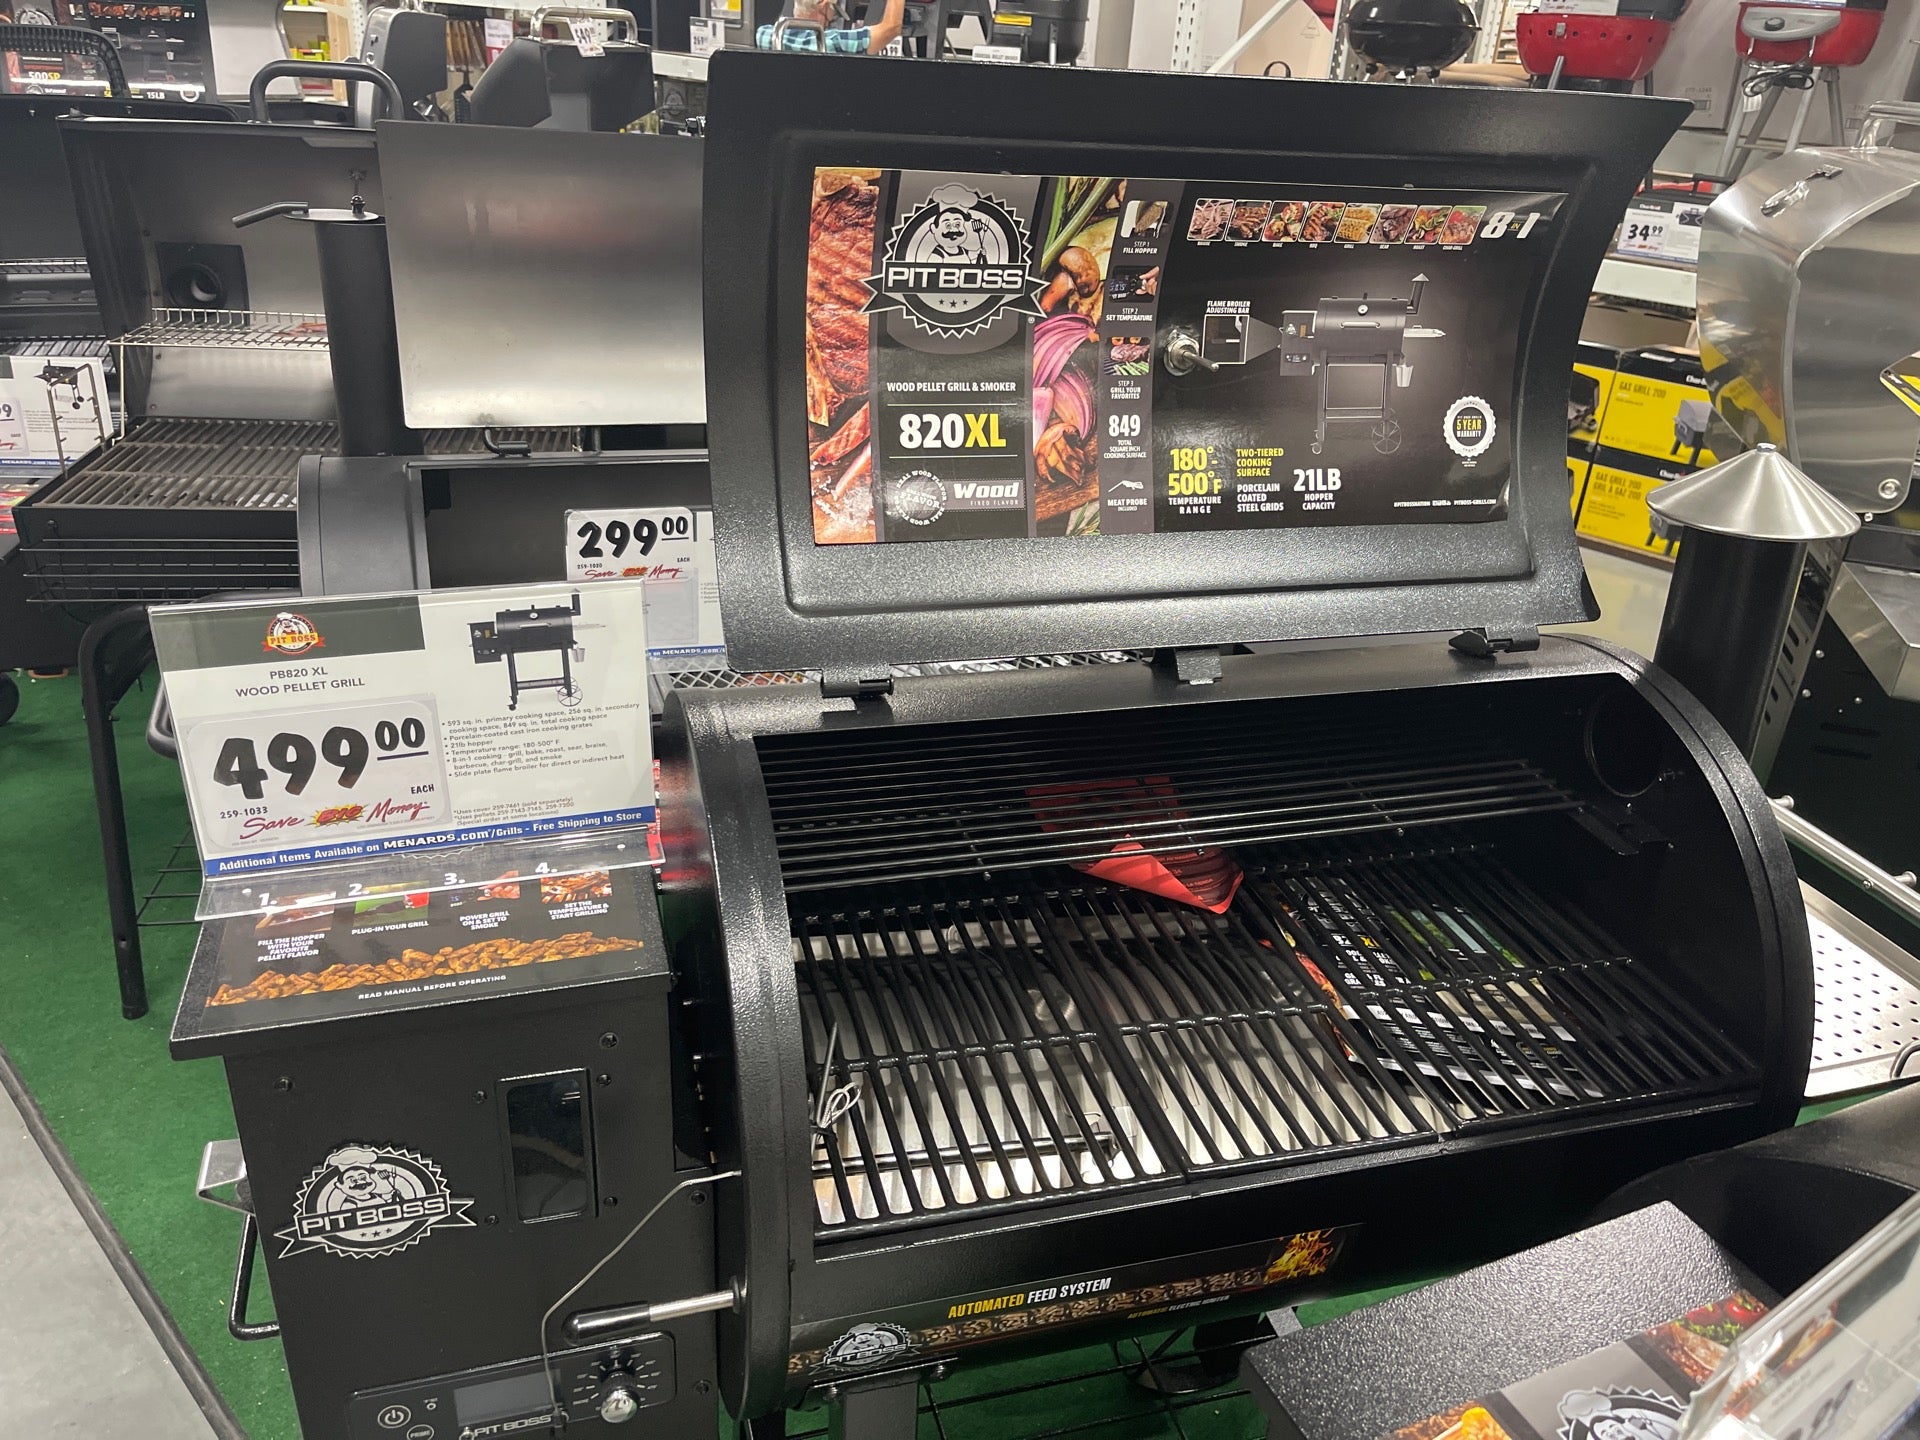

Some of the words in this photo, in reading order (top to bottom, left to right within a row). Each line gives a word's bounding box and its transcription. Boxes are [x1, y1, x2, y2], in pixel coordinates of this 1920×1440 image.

[1480, 212, 1515, 238] 8
[1517, 212, 1540, 239] 1
[1628, 224, 1650, 241] 34
[1652, 226, 1663, 234] 99
[888, 267, 936, 288] PIT
[938, 268, 1023, 289] BOSS
[887, 382, 915, 392] WOOD
[917, 382, 946, 392] PELLET
[948, 382, 970, 392] GRILL
[972, 382, 978, 392] &
[980, 382, 1016, 392] SMOKER
[1619, 381, 1633, 391] GAS
[1634, 384, 1651, 396] GRILL
[1653, 388, 1666, 398] 200
[1109, 415, 1140, 437] 849
[1457, 419, 1461, 430] 5
[1463, 419, 1482, 430] YEAR
[900, 413, 1006, 449] 820XL
[1236, 448, 1284, 457] TWO-TIERED
[1236, 458, 1272, 467] COOKING
[1237, 468, 1270, 477] SURFACE
[1293, 468, 1342, 492] 21LB
[1596, 472, 1608, 481] GAS
[1609, 475, 1626, 487] GRILL
[954, 482, 1019, 498] Wood
[1237, 484, 1280, 493] PORCELAIN
[1168, 496, 1221, 506] TEMPERATURE
[1237, 493, 1267, 502] COATED
[1304, 493, 1333, 502] HOPPER
[1180, 506, 1211, 514] RANGE
[1237, 503, 1259, 512] STEEL
[1260, 502, 1284, 511] GRIDS
[1303, 502, 1335, 511] CAPACITY
[577, 519, 658, 558] 299
[662, 516, 688, 535] 00
[585, 570, 617, 579] Save
[649, 565, 683, 579] Money
[270, 636, 287, 645] PIT
[292, 634, 315, 643] BOSS
[270, 668, 308, 679] PB820
[312, 667, 328, 676] XL
[236, 686, 279, 697] WOOD
[284, 681, 327, 693] PELLET
[331, 677, 365, 688] GRILL
[486, 716, 513, 724] primary
[515, 712, 542, 720] cooking
[605, 703, 640, 711] secondary
[449, 726, 477, 734] cooking
[450, 731, 508, 740] Porcelain-coated
[451, 747, 496, 756] Temperature
[214, 726, 369, 799] 499
[375, 717, 425, 751] 00
[411, 784, 434, 794] EACH
[220, 806, 268, 819] 259-1033
[239, 816, 305, 840] Save
[366, 798, 430, 820] Money
[219, 856, 277, 871] Additional
[279, 852, 310, 864] Items
[315, 846, 363, 859] Available
[533, 823, 555, 831] Free
[558, 817, 600, 829] Shipping
[603, 815, 612, 823] to
[616, 812, 641, 821] Store
[535, 862, 558, 874] 4.
[444, 873, 465, 885] 3.
[258, 893, 277, 906] 1.
[549, 904, 602, 915] TEMPERATURE
[575, 908, 608, 917] GRILLING
[460, 913, 488, 922] POWER
[352, 926, 384, 935] PLUG-IN
[385, 923, 407, 931] YOUR
[471, 922, 499, 930] SMOKE
[291, 933, 325, 942] HOPPER
[286, 940, 314, 948] YOUR
[258, 954, 286, 962] PELLET
[287, 949, 319, 958] FLAVOR
[270, 946, 309, 955] FAVORITE
[384, 986, 422, 996] MANUAL
[424, 982, 456, 990] BEFORE
[459, 975, 506, 986] OPERATING
[302, 1213, 351, 1234] PIT
[356, 1198, 445, 1226] BOSS
[948, 1293, 1024, 1319] AUTOMATED
[1027, 1288, 1057, 1305] FEED
[1060, 1277, 1111, 1298] SYSTEM
[827, 1356, 856, 1365] PIT
[857, 1344, 906, 1358] BOSS
[474, 1424, 501, 1436] PIT
[503, 1415, 551, 1431] BOSS
